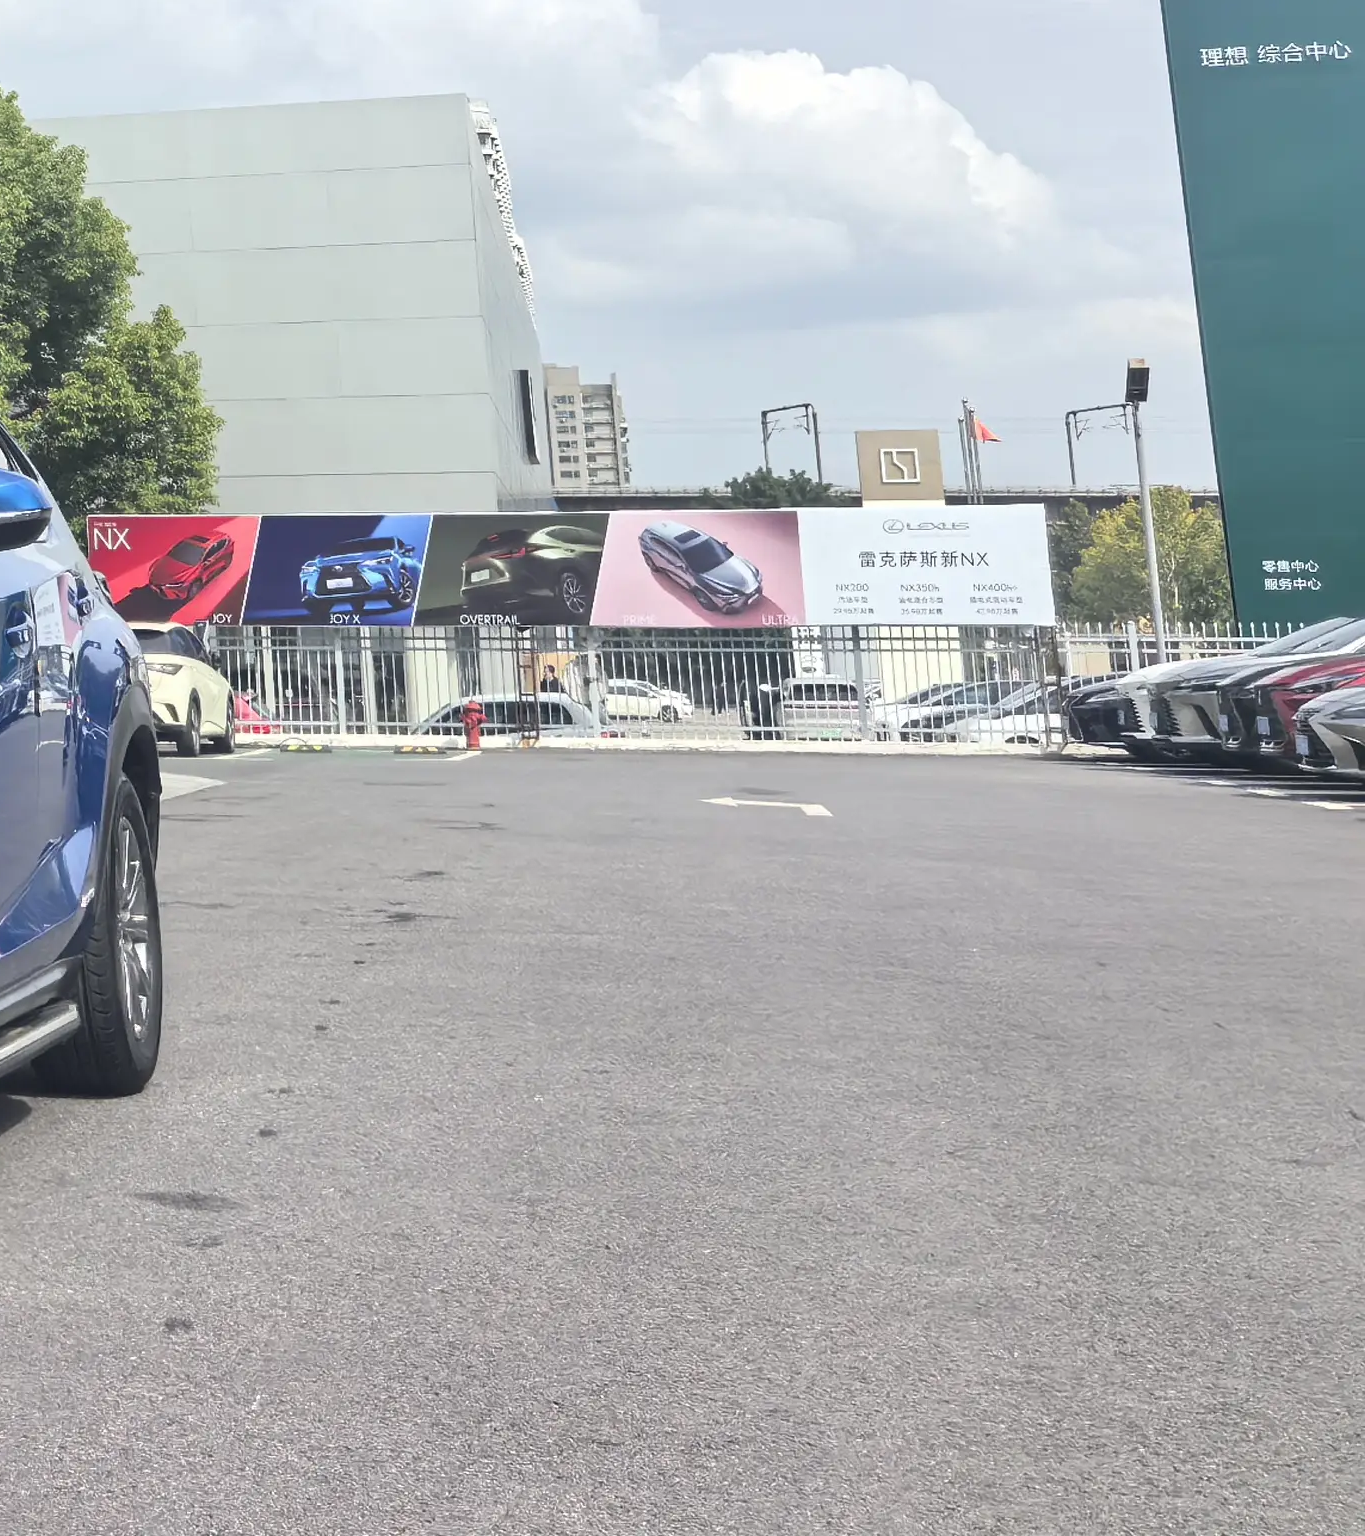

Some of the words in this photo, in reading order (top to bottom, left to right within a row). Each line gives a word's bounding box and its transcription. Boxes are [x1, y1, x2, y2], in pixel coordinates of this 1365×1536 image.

[1199, 45, 1250, 68] 理想
[1256, 40, 1352, 65] 综合中心
[906, 521, 970, 531] LEXUS
[93, 528, 132, 550] NX
[857, 550, 990, 568] 雷克萨斯新NX
[1261, 560, 1320, 573] 零售中心
[835, 582, 869, 592] NX200
[900, 582, 940, 593] NX350h
[1264, 577, 1322, 590] 服务中心
[212, 613, 233, 624] JOY
[352, 614, 361, 625] X
[459, 614, 521, 626] OVERTRAIL
